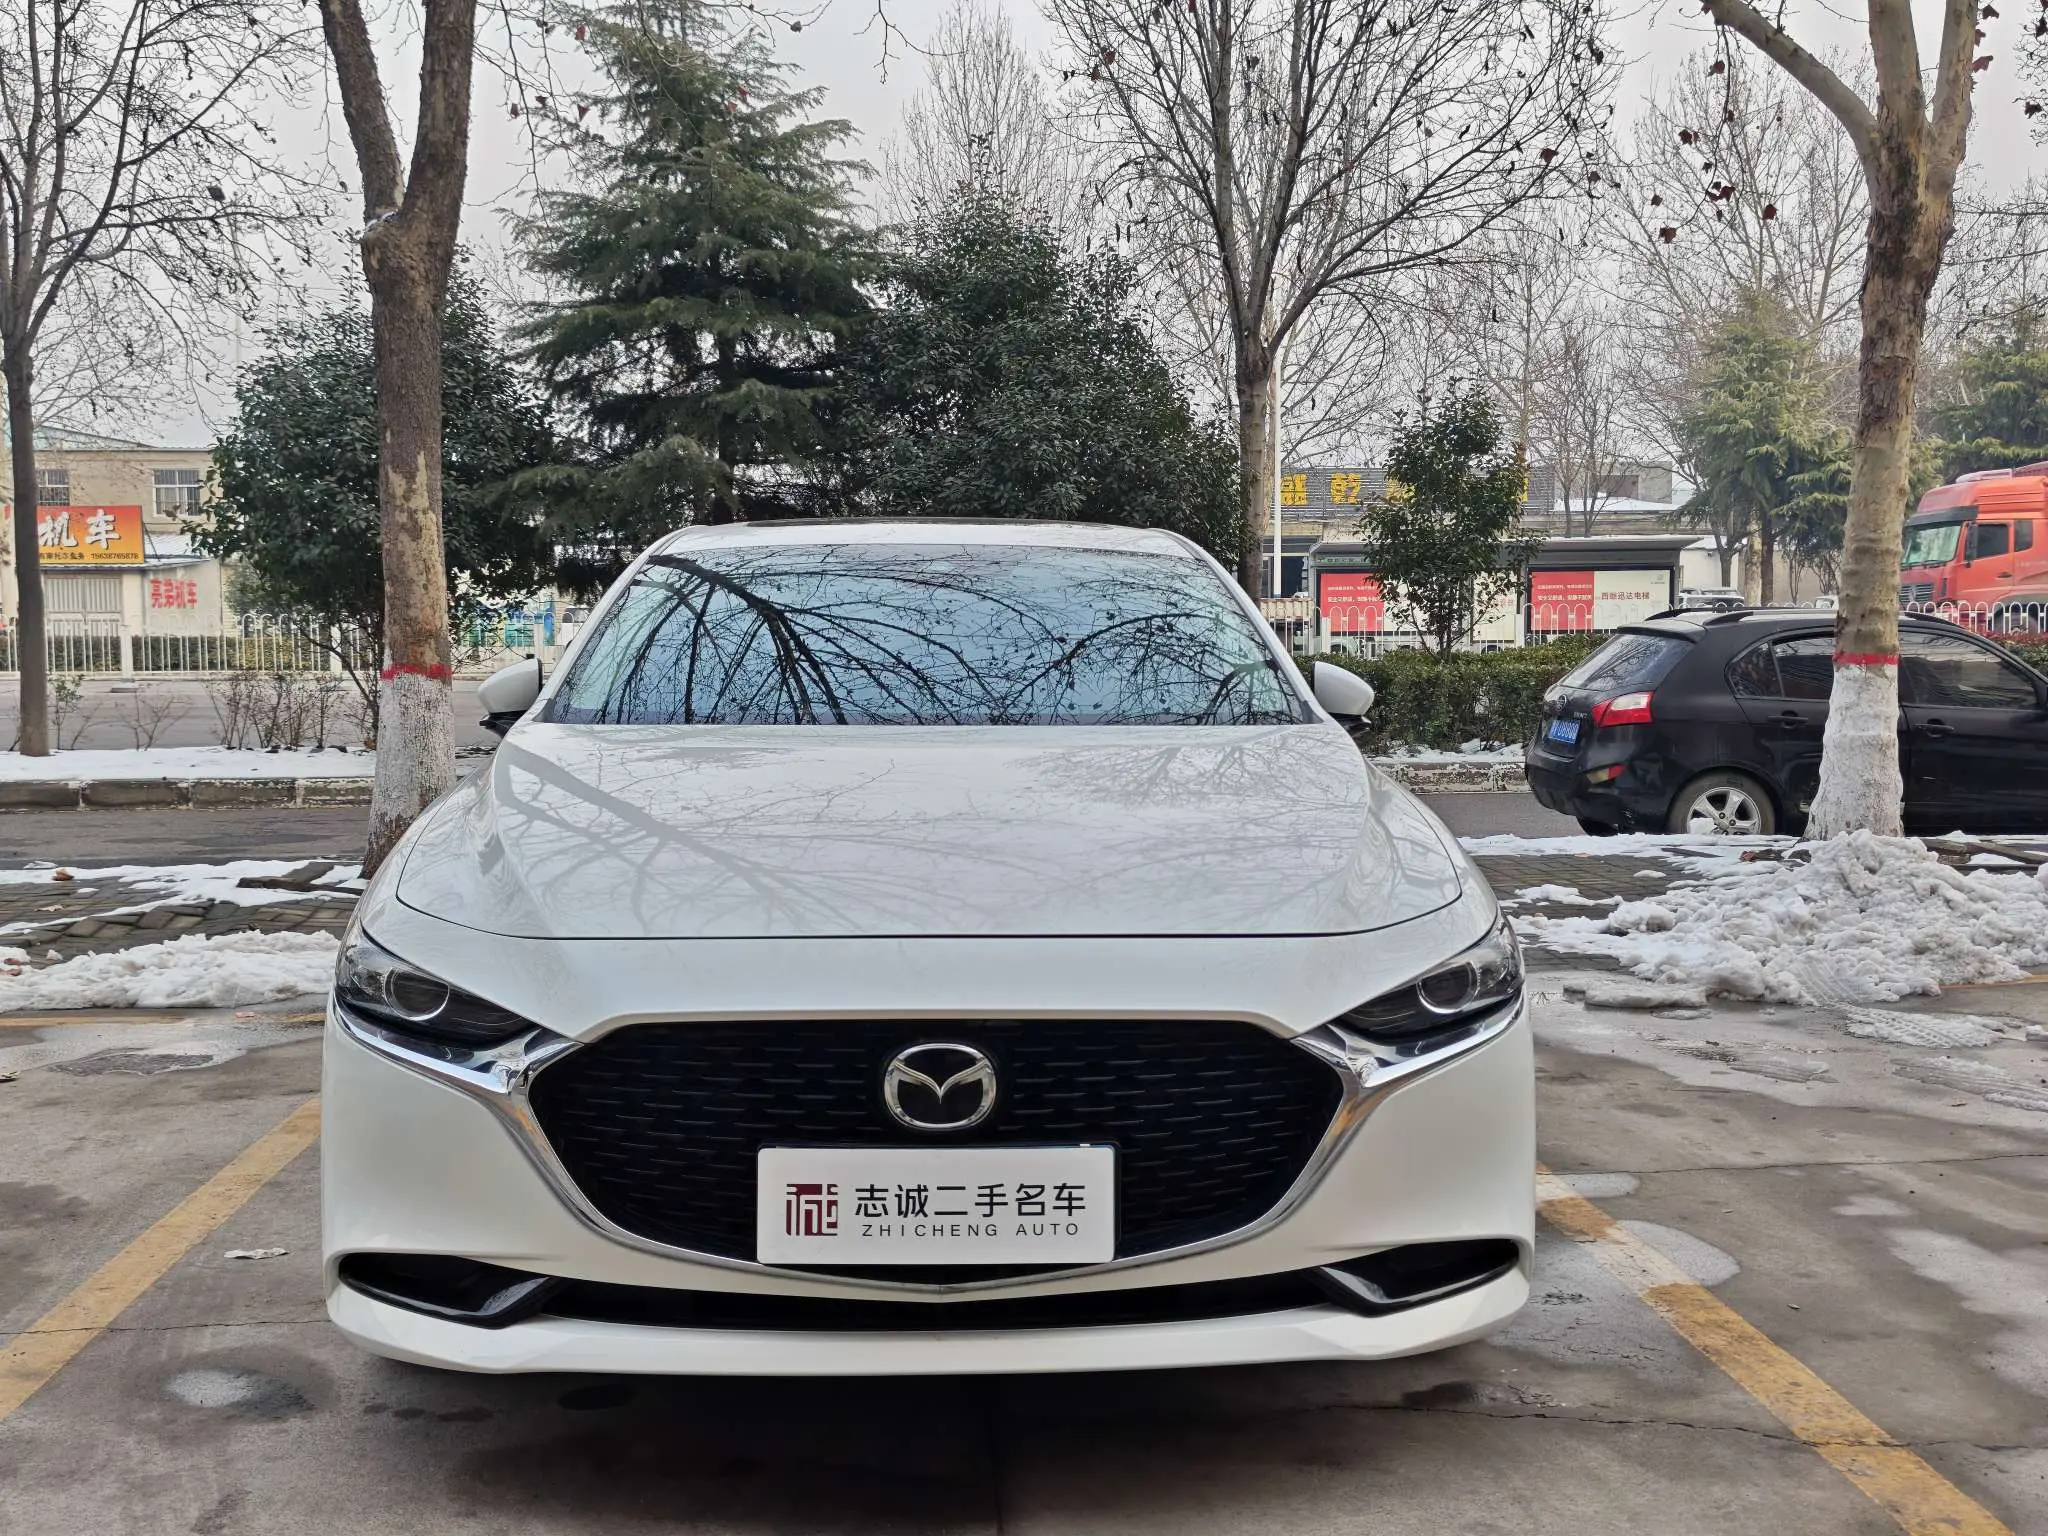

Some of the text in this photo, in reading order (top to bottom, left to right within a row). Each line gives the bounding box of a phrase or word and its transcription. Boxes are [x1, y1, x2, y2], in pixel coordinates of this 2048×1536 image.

[854, 1182, 1087, 1219] 志诚二手名车
[862, 1222, 1079, 1237] ZHICHENG AUTO
